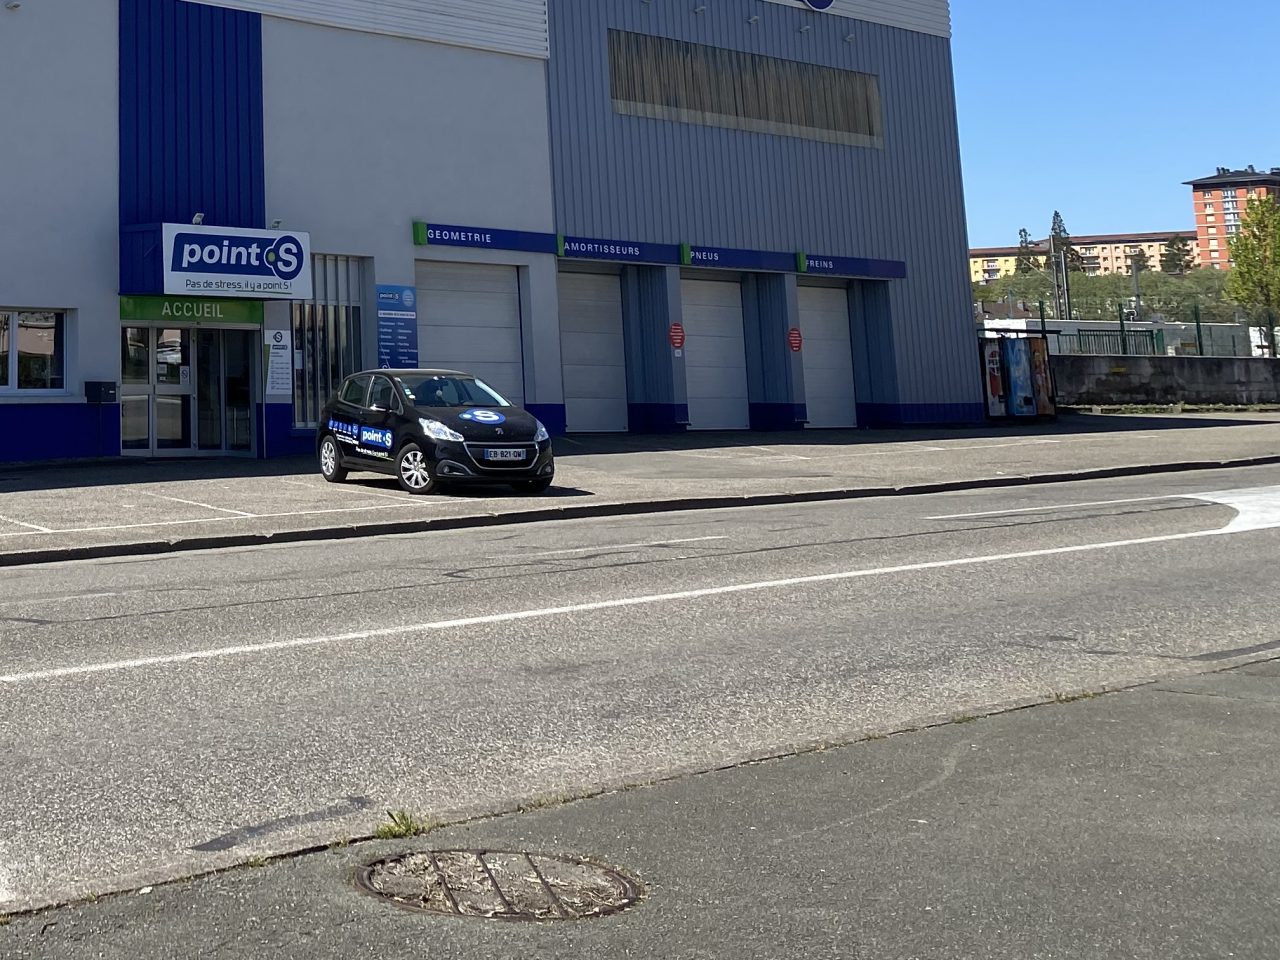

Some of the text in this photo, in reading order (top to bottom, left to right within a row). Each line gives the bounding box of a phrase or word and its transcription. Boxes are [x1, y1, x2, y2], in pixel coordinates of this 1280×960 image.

[427, 229, 492, 243] GEOMETRIE
[564, 241, 640, 256] AMORTISSEURS
[690, 250, 719, 261] PNEUS
[181, 239, 298, 273] point S
[806, 258, 834, 269] FREINS
[185, 279, 201, 289] Pas
[203, 279, 214, 289] de
[214, 280, 244, 290] stress,
[262, 281, 282, 291] point
[161, 301, 224, 318] ACCUEIL
[362, 429, 382, 443] point
[385, 431, 392, 446] S
